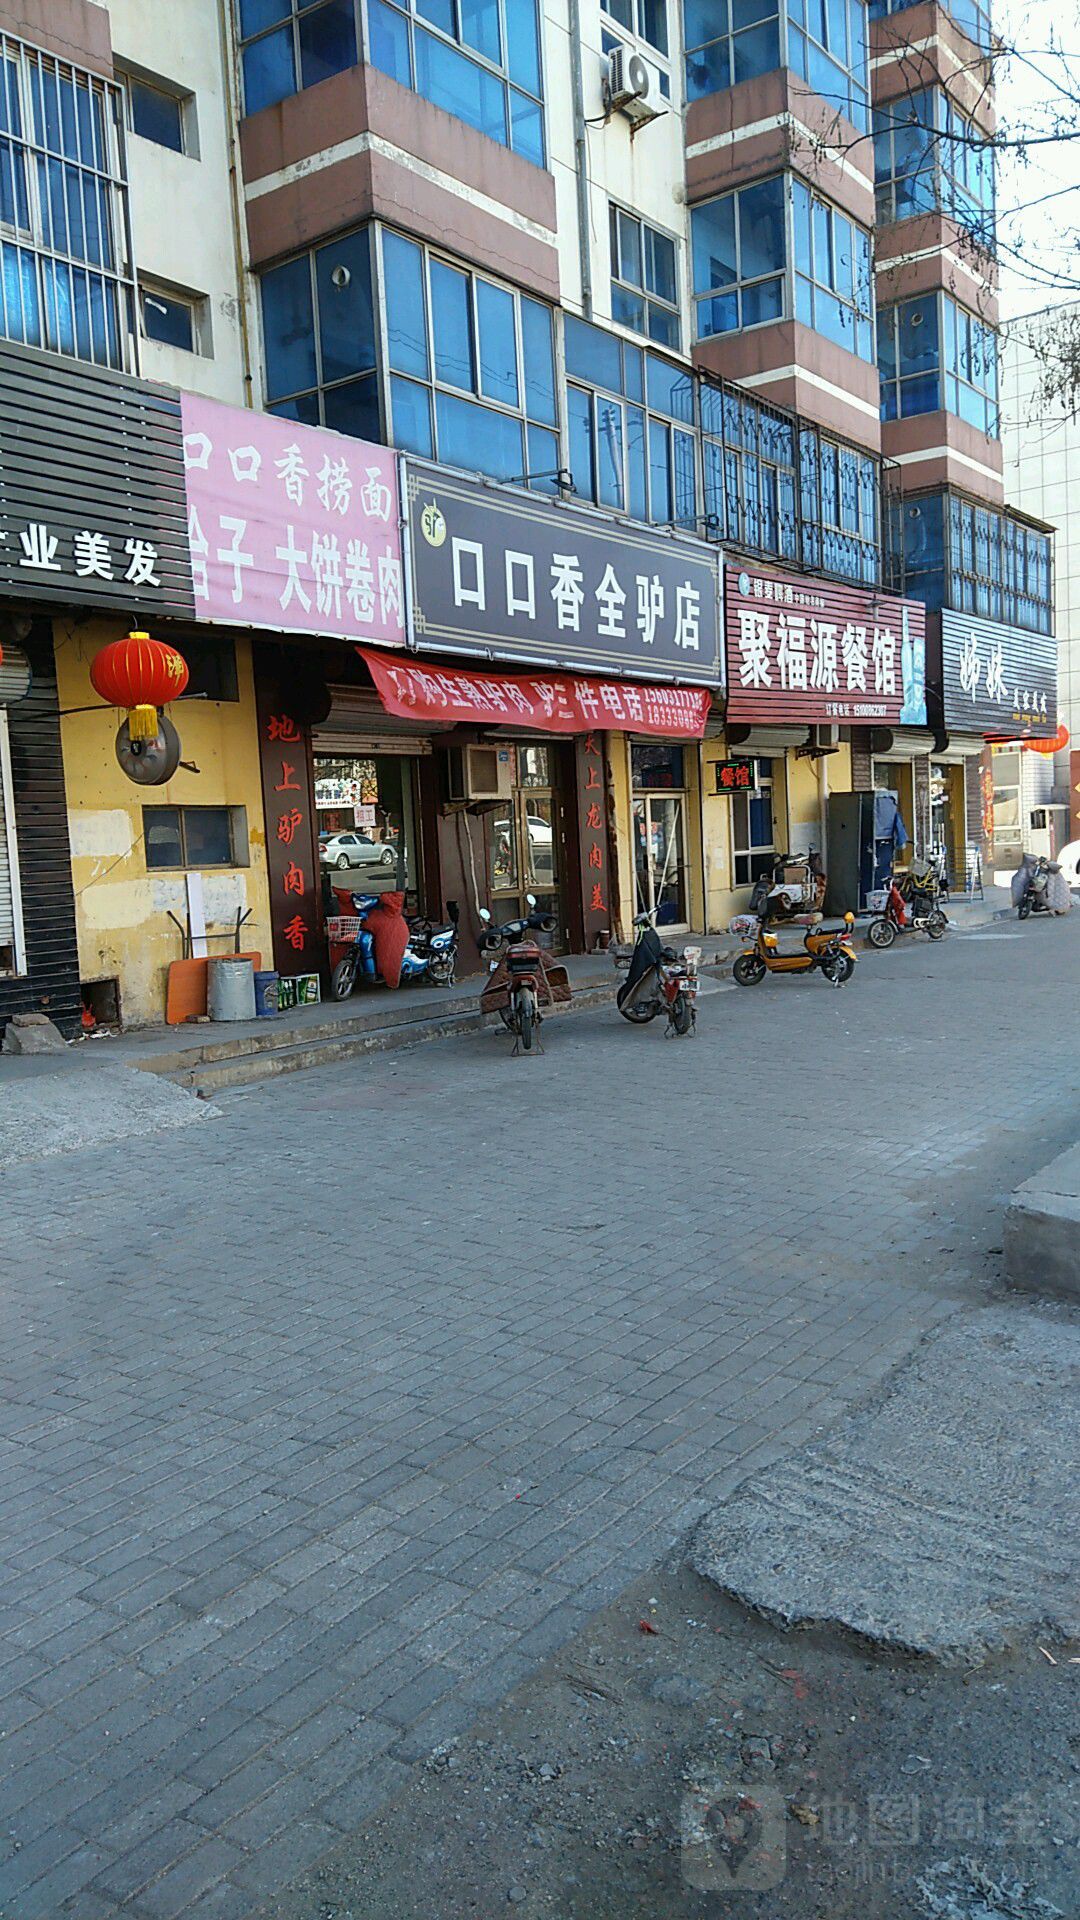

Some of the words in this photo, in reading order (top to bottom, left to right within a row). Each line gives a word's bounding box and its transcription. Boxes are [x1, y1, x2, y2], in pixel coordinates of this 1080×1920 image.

[182, 432, 392, 522] 口口香捞面
[0, 523, 161, 587] 业美发
[275, 524, 403, 628] 大饼卷肉
[451, 536, 700, 651] 口口香全驴店
[736, 608, 896, 696] 聚福源餐馆
[721, 766, 750, 787] 餐馆
[267, 714, 308, 951] 地上驴肉香
